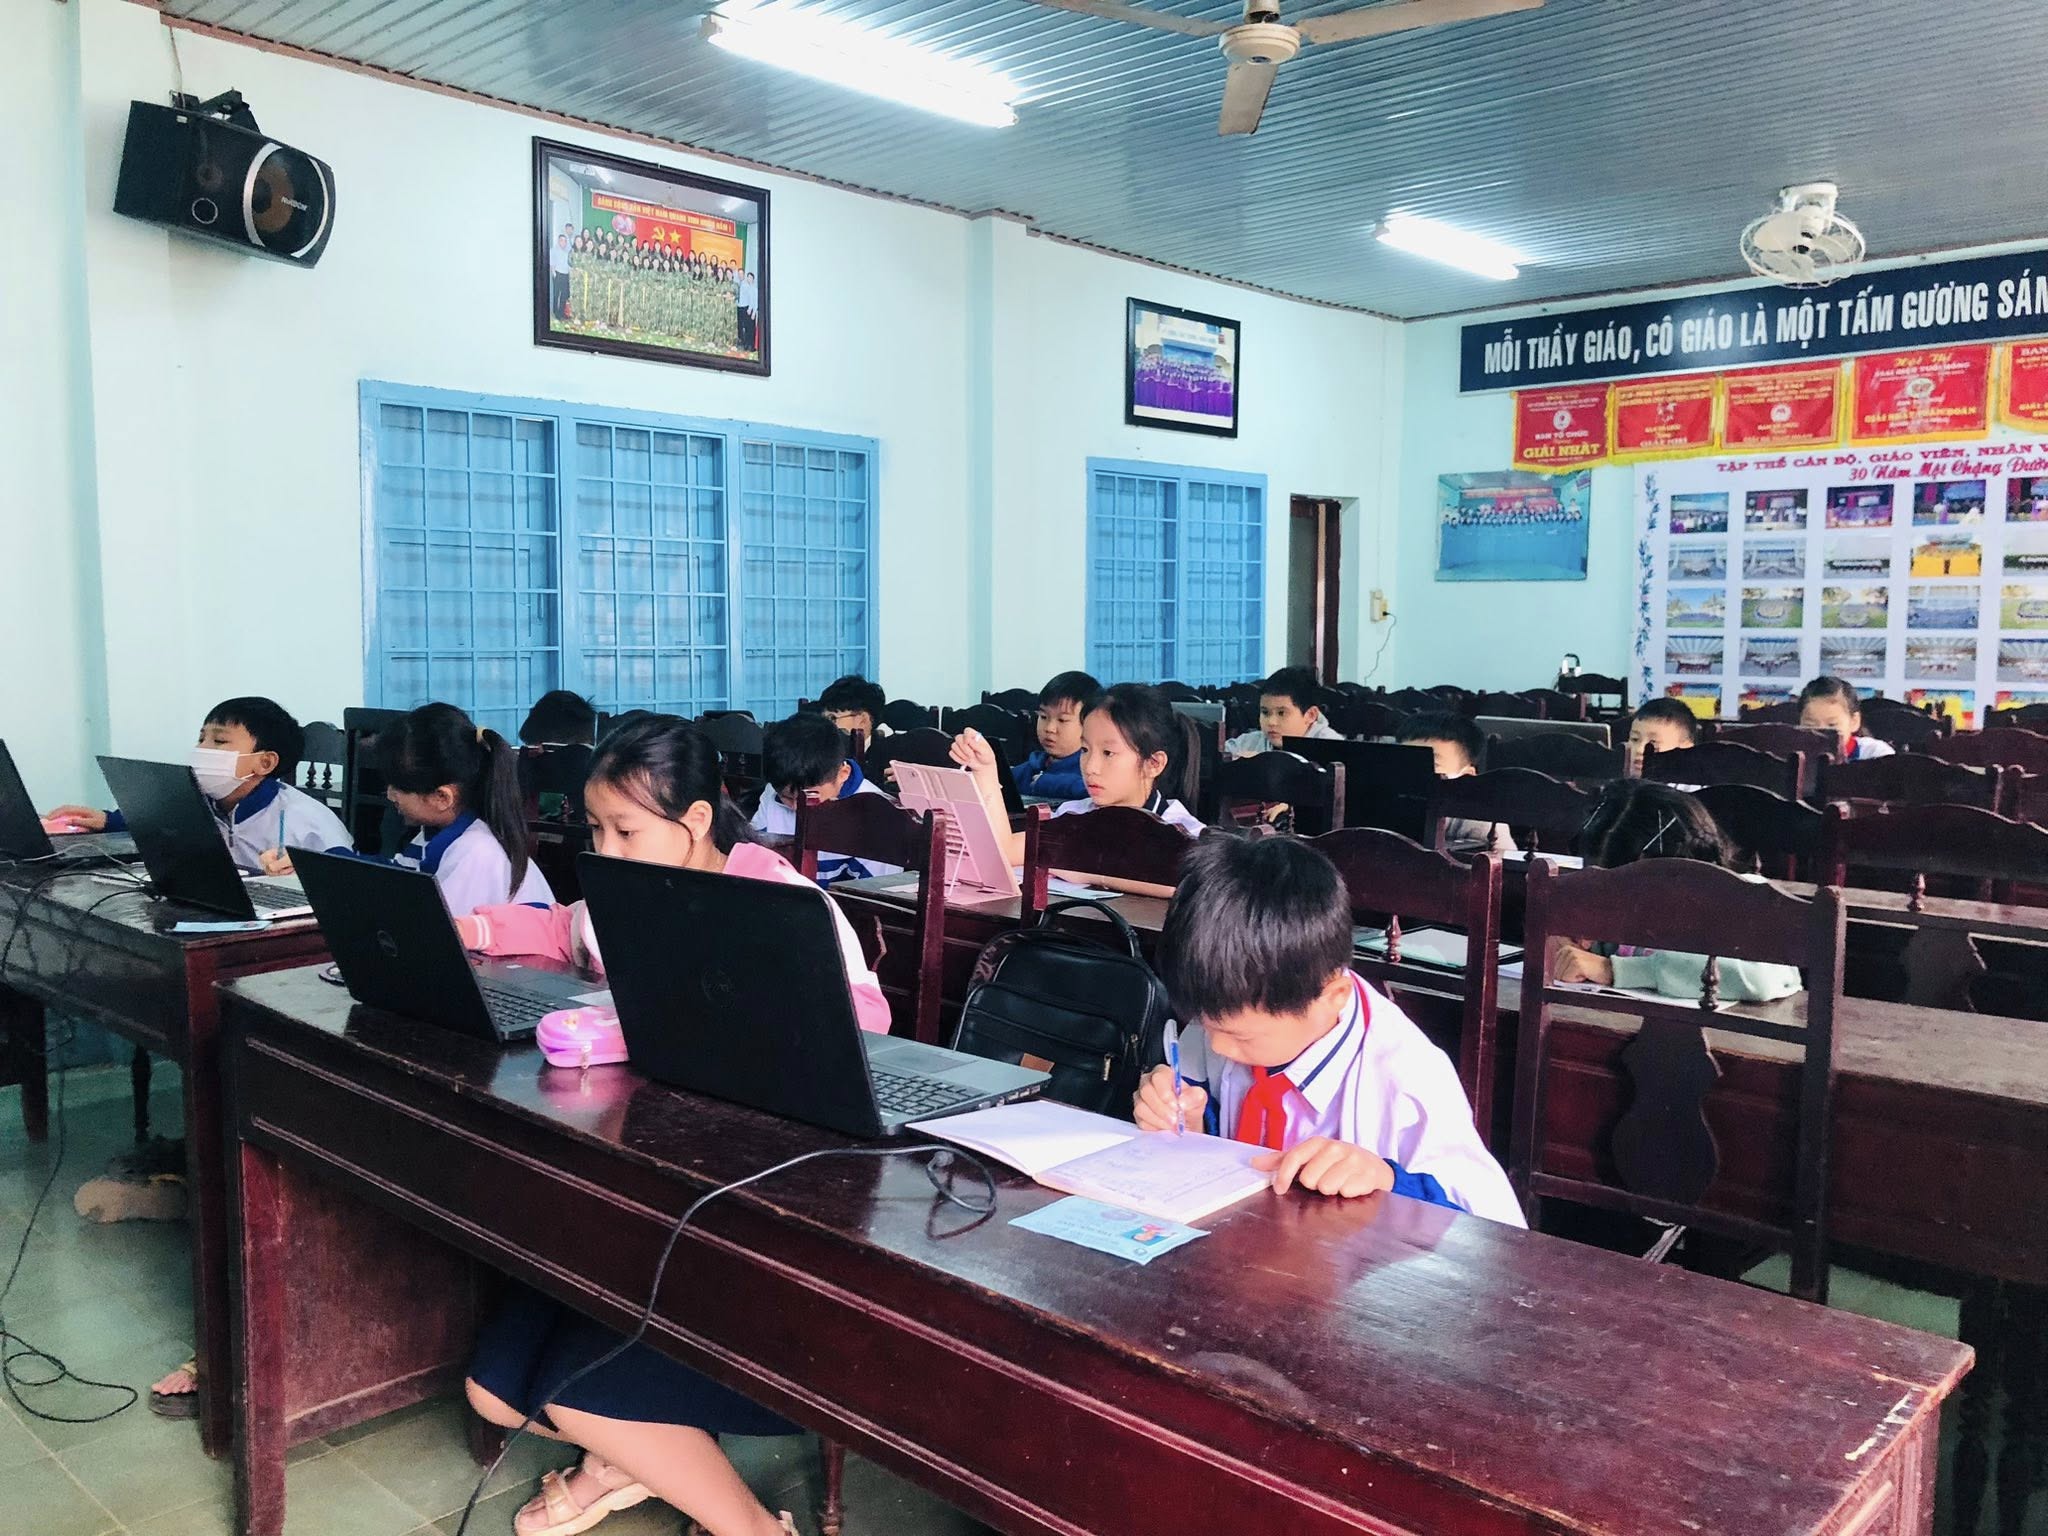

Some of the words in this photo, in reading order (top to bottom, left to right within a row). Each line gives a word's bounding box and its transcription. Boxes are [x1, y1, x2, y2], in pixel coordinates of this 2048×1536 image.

[1484, 328, 1521, 374] MỖI
[1527, 322, 1578, 370] THẦY
[1584, 320, 1640, 364] GIÁO,
[1646, 315, 1673, 358] CÔ
[1681, 308, 1733, 354] GIÁO
[1740, 302, 1768, 348] LÀ
[1776, 297, 1831, 349] MỘT
[1838, 285, 1894, 336] TẤM
[1902, 282, 1989, 330] GƯƠNG
[1717, 461, 1748, 472] TẬP
[1794, 454, 1828, 467] CÁN
[1869, 451, 1913, 463] GIÁO
[1978, 443, 2033, 457] NHÂN
[1850, 468, 1868, 480] 30
